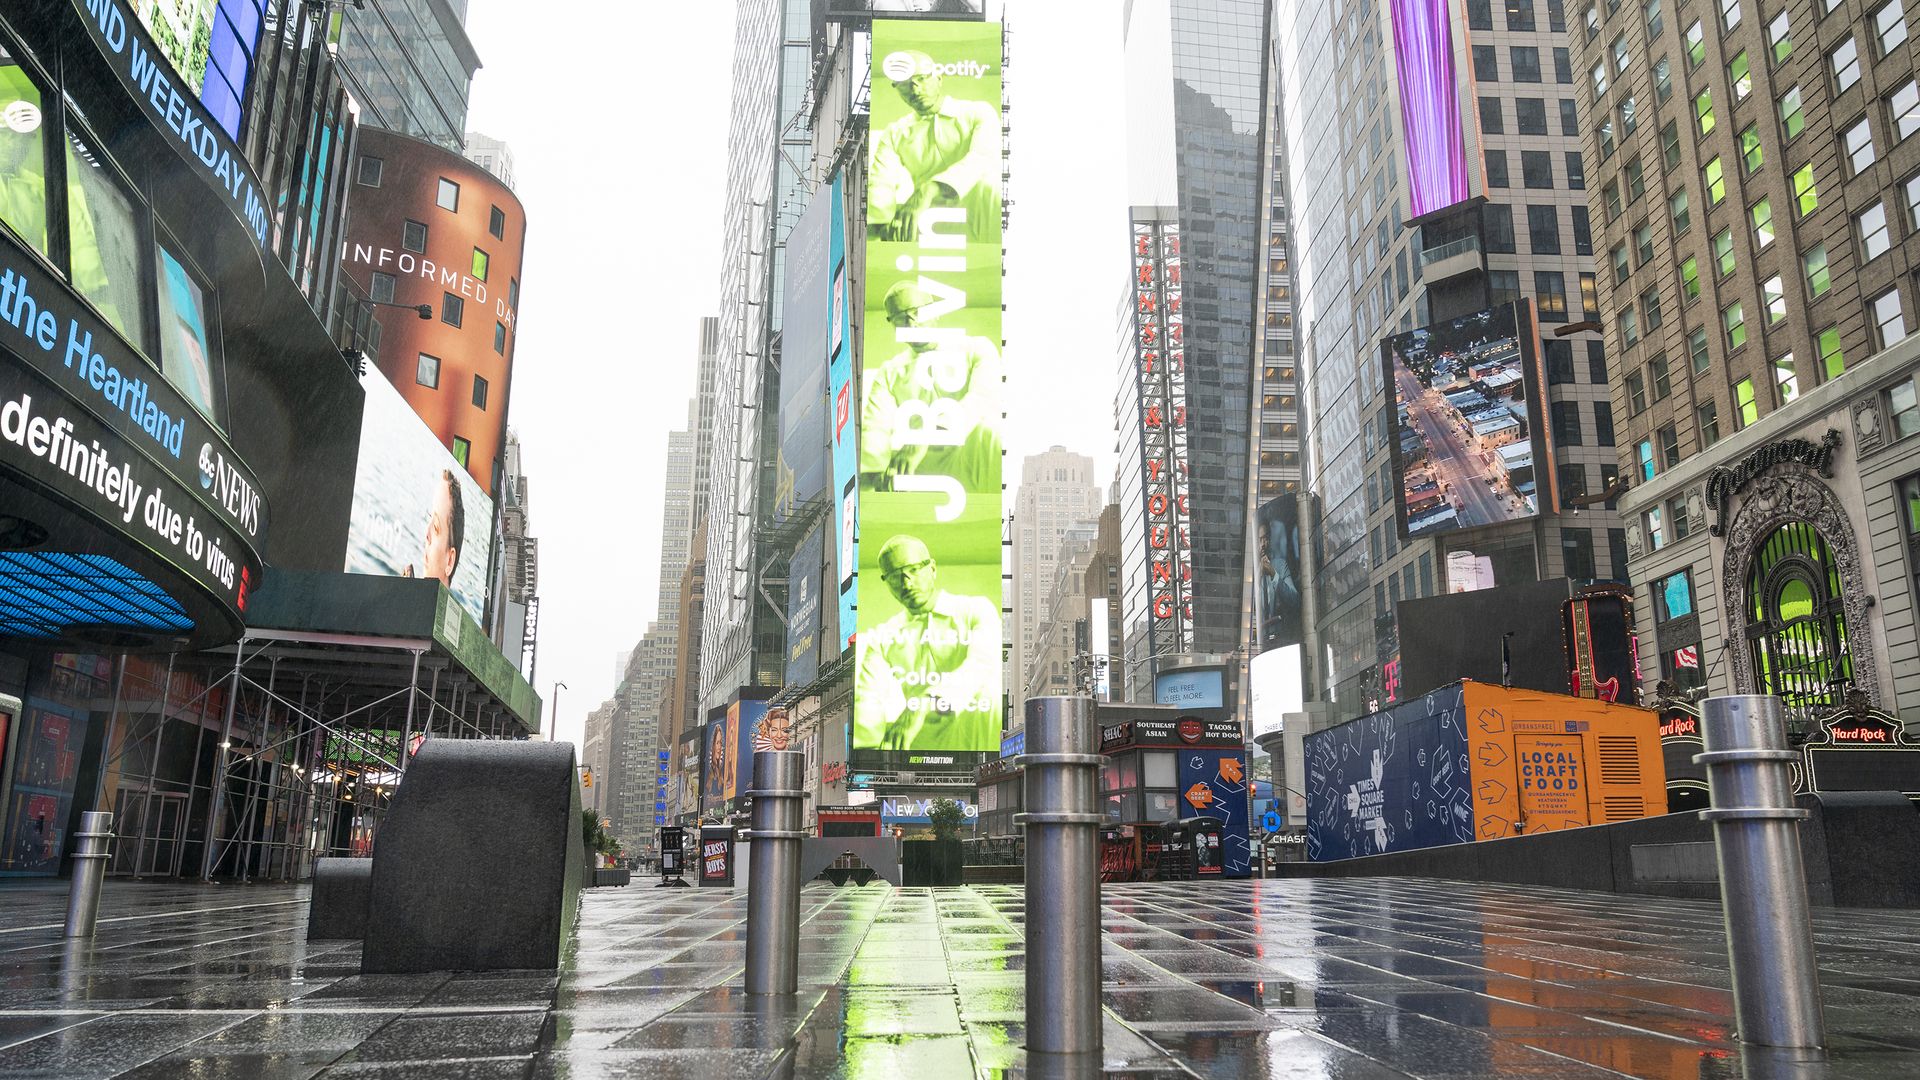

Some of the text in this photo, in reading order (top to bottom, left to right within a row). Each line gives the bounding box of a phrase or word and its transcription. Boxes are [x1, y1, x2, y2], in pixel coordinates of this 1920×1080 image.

[919, 59, 988, 79] Spotify
[86, 0, 125, 53] ND
[130, 36, 245, 199] WEEKDAY
[341, 241, 517, 336] INFORMED DAT
[0, 268, 185, 458] the Heartland
[893, 207, 967, 522] J Balvin
[1138, 236, 1172, 619] ERNST & YOUNG
[1, 394, 235, 590] definitely due to virus
[211, 452, 260, 536] NEWS
[523, 599, 538, 641] Locker
[1136, 721, 1176, 729] SOUTHEAST
[1208, 723, 1232, 731] TACOS
[1659, 716, 1696, 736] ard Rock
[1832, 727, 1886, 742] Hard Rock
[1521, 752, 1577, 764] LOCAL
[1522, 765, 1578, 777] CRAFT
[1357, 779, 1374, 792] TIMES
[1524, 778, 1578, 790] FOOD
[1361, 790, 1384, 806] SQUARE
[882, 799, 914, 817] NEW
[1359, 805, 1383, 820] MARKET
[703, 840, 728, 858] JERSEY
[706, 858, 726, 874] BOYS
